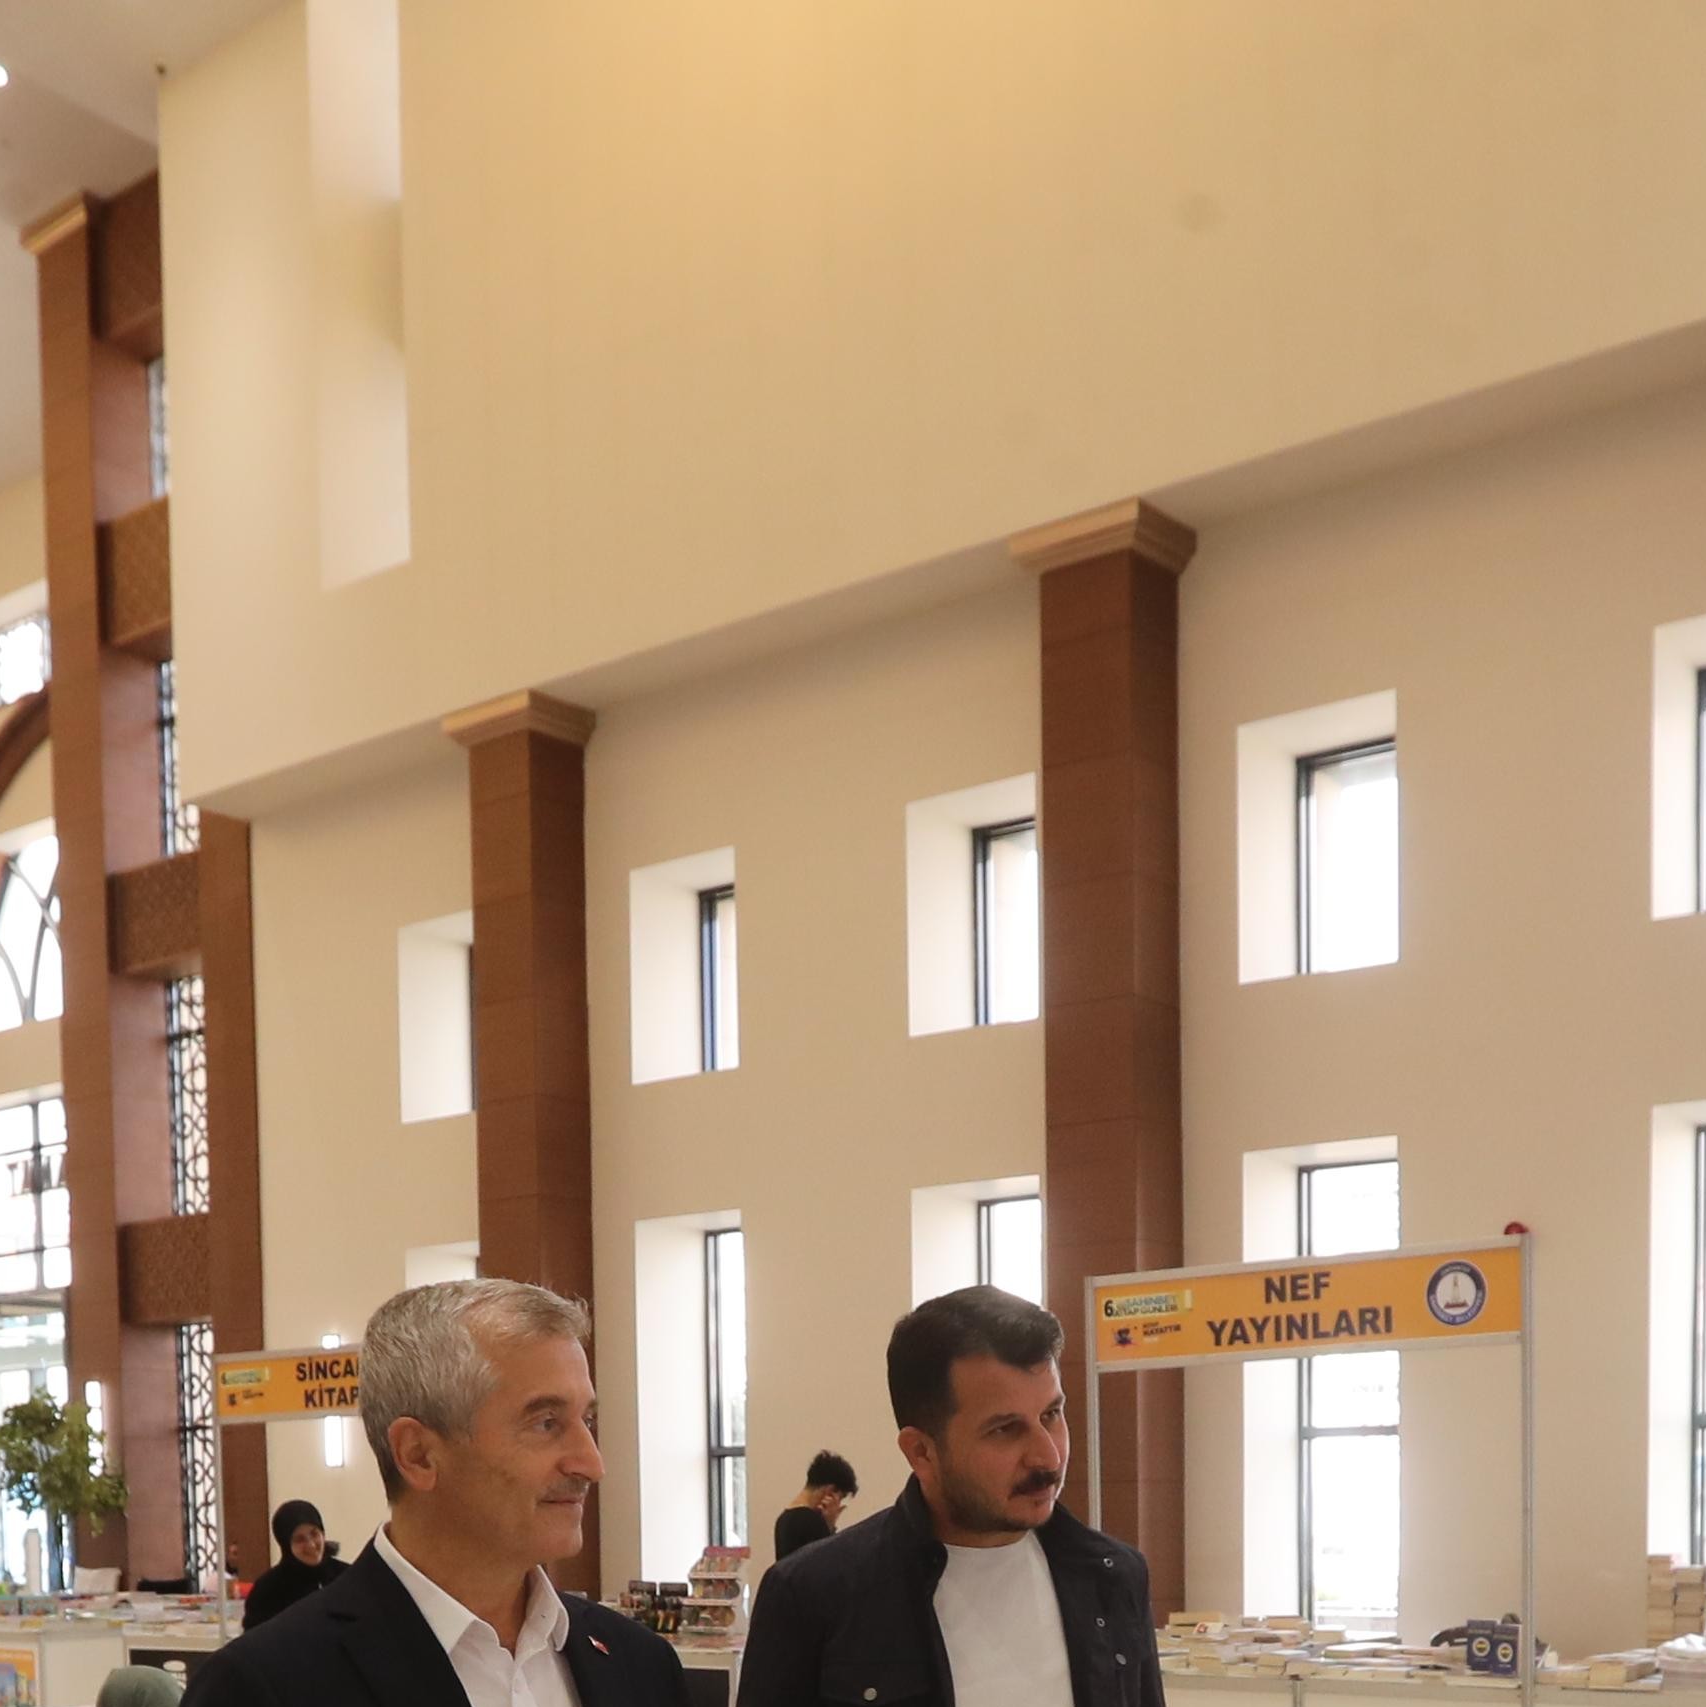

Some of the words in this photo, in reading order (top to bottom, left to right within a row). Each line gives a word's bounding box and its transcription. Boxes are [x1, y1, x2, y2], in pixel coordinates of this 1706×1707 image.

[1264, 1271, 1330, 1304] NEF
[1207, 1306, 1392, 1347] YAYINLARI
[296, 1357, 359, 1382] SİNCA
